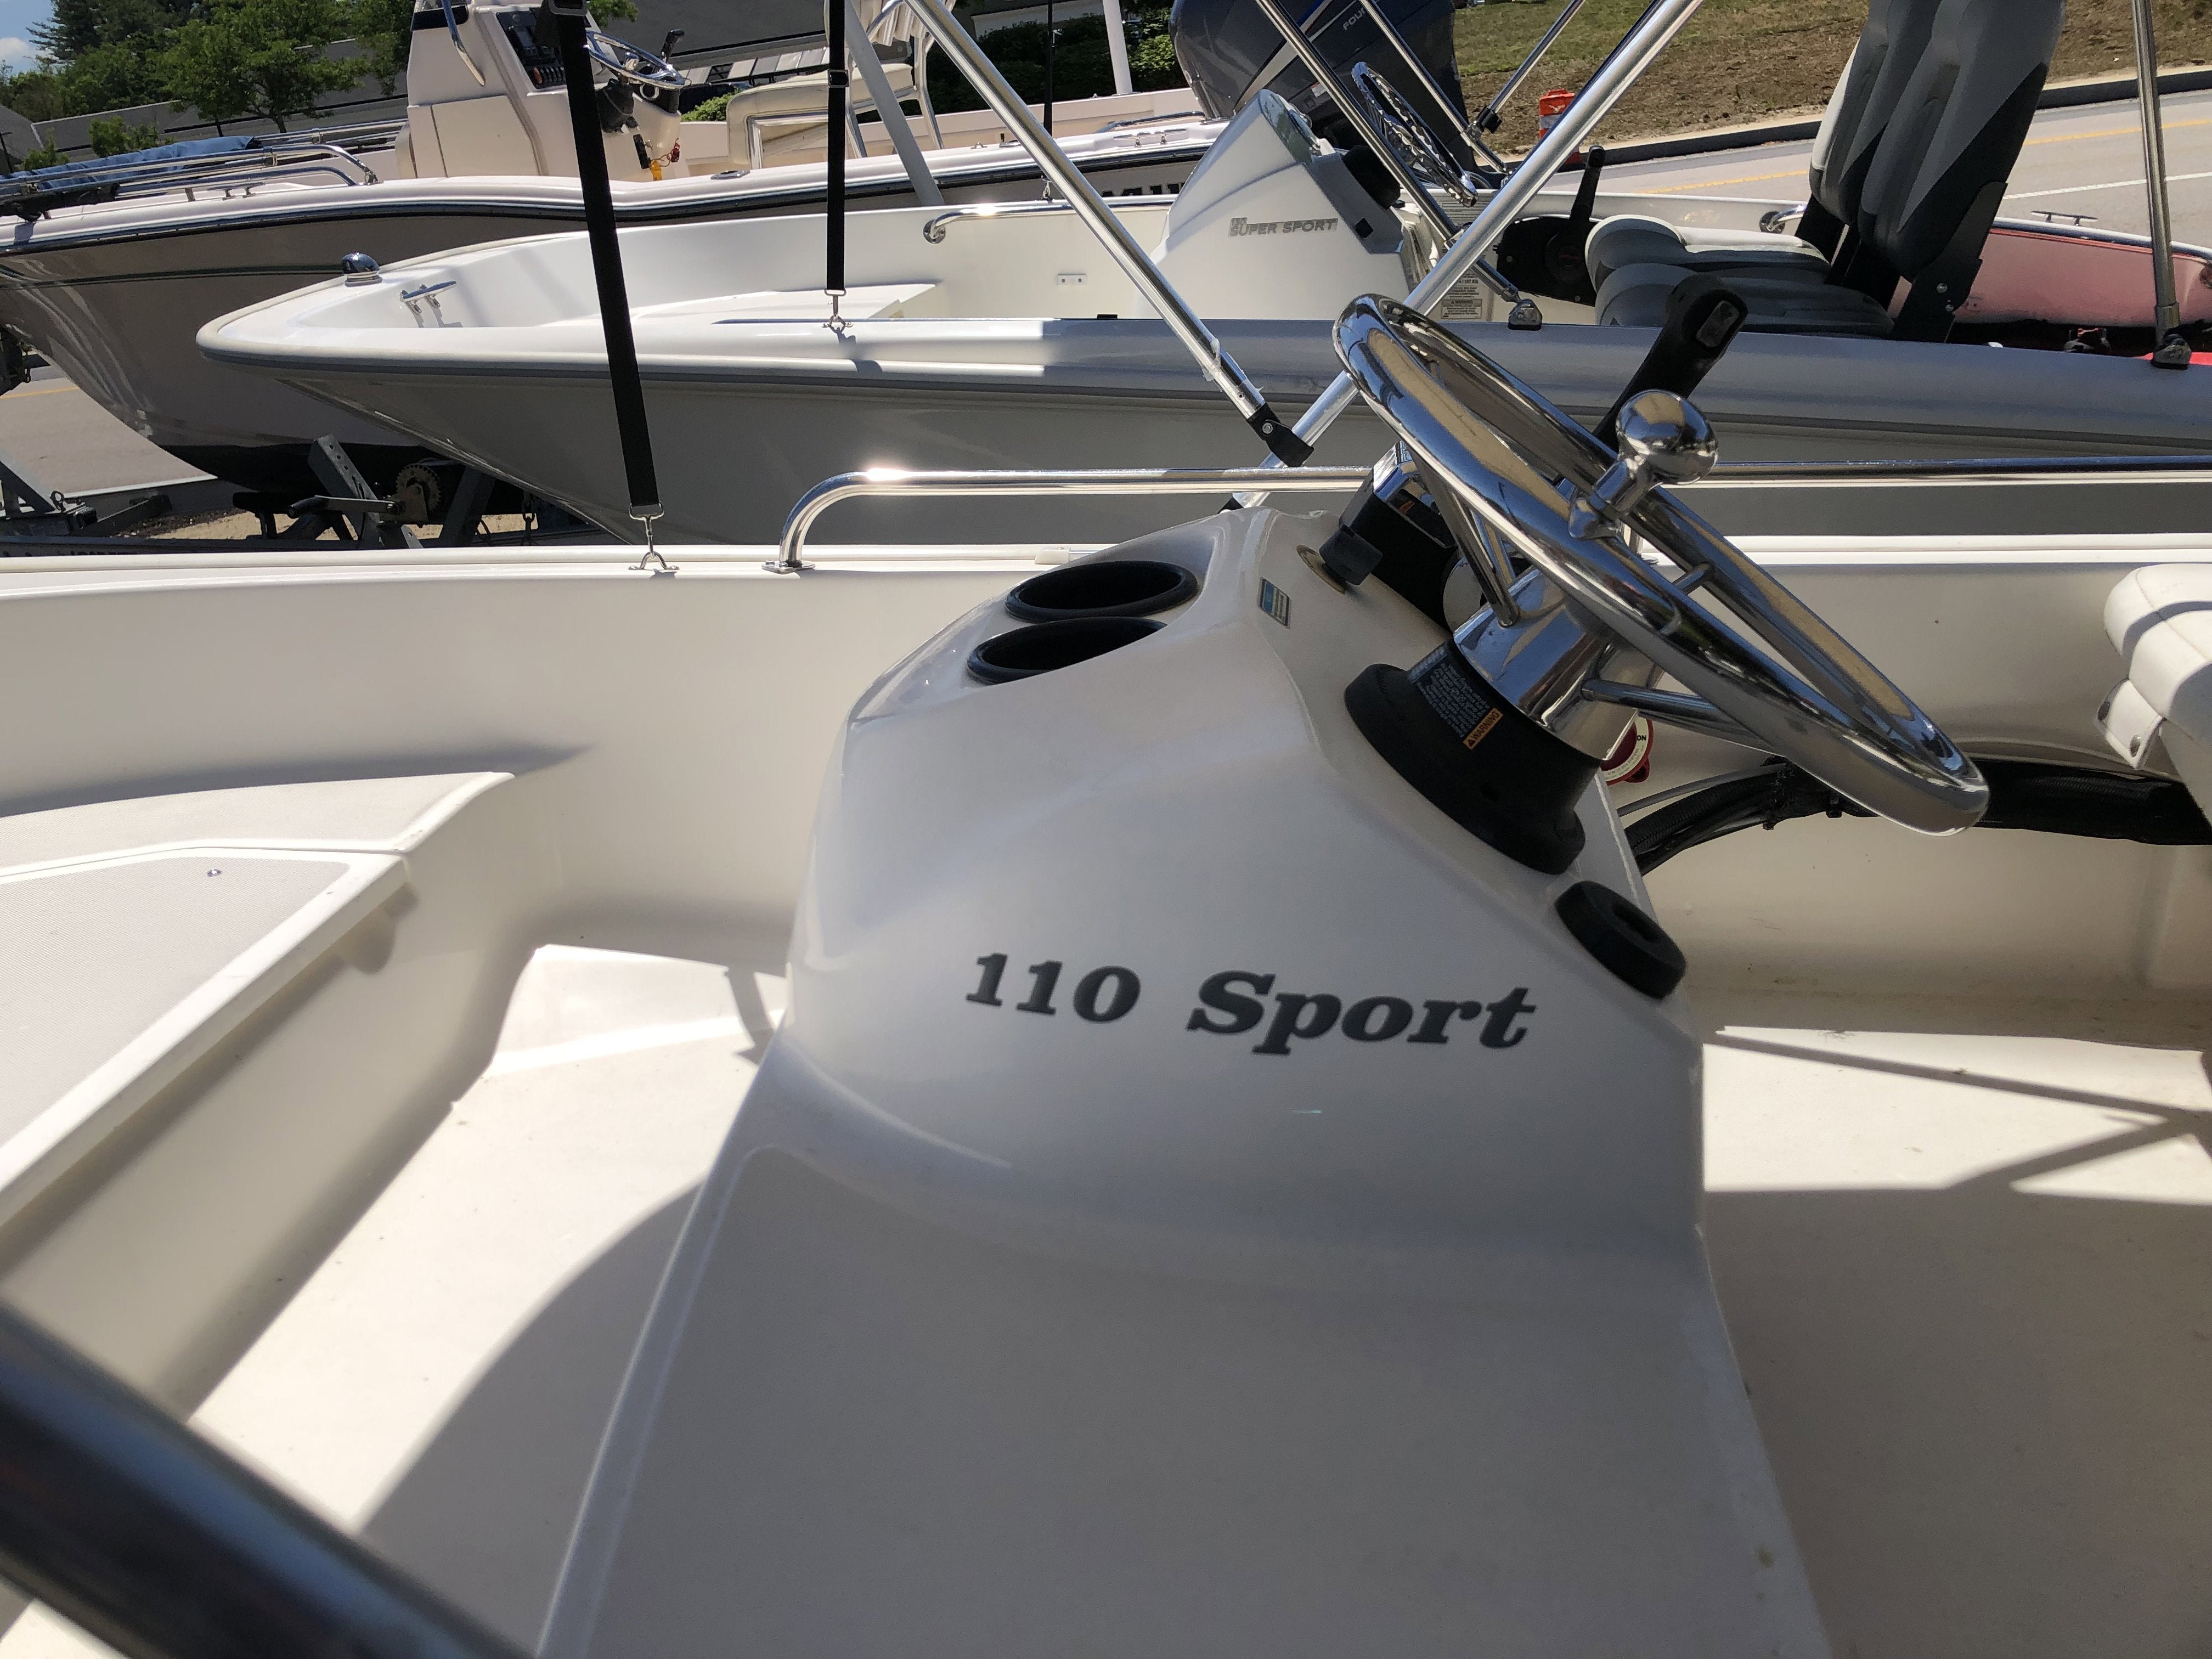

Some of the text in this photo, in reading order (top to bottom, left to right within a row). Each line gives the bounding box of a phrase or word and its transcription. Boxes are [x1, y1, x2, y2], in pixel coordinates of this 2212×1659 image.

[1230, 219, 1335, 237] SUPER SPORT
[1470, 710, 1500, 741] WARNING
[966, 952, 1536, 1056] 110 Sport
